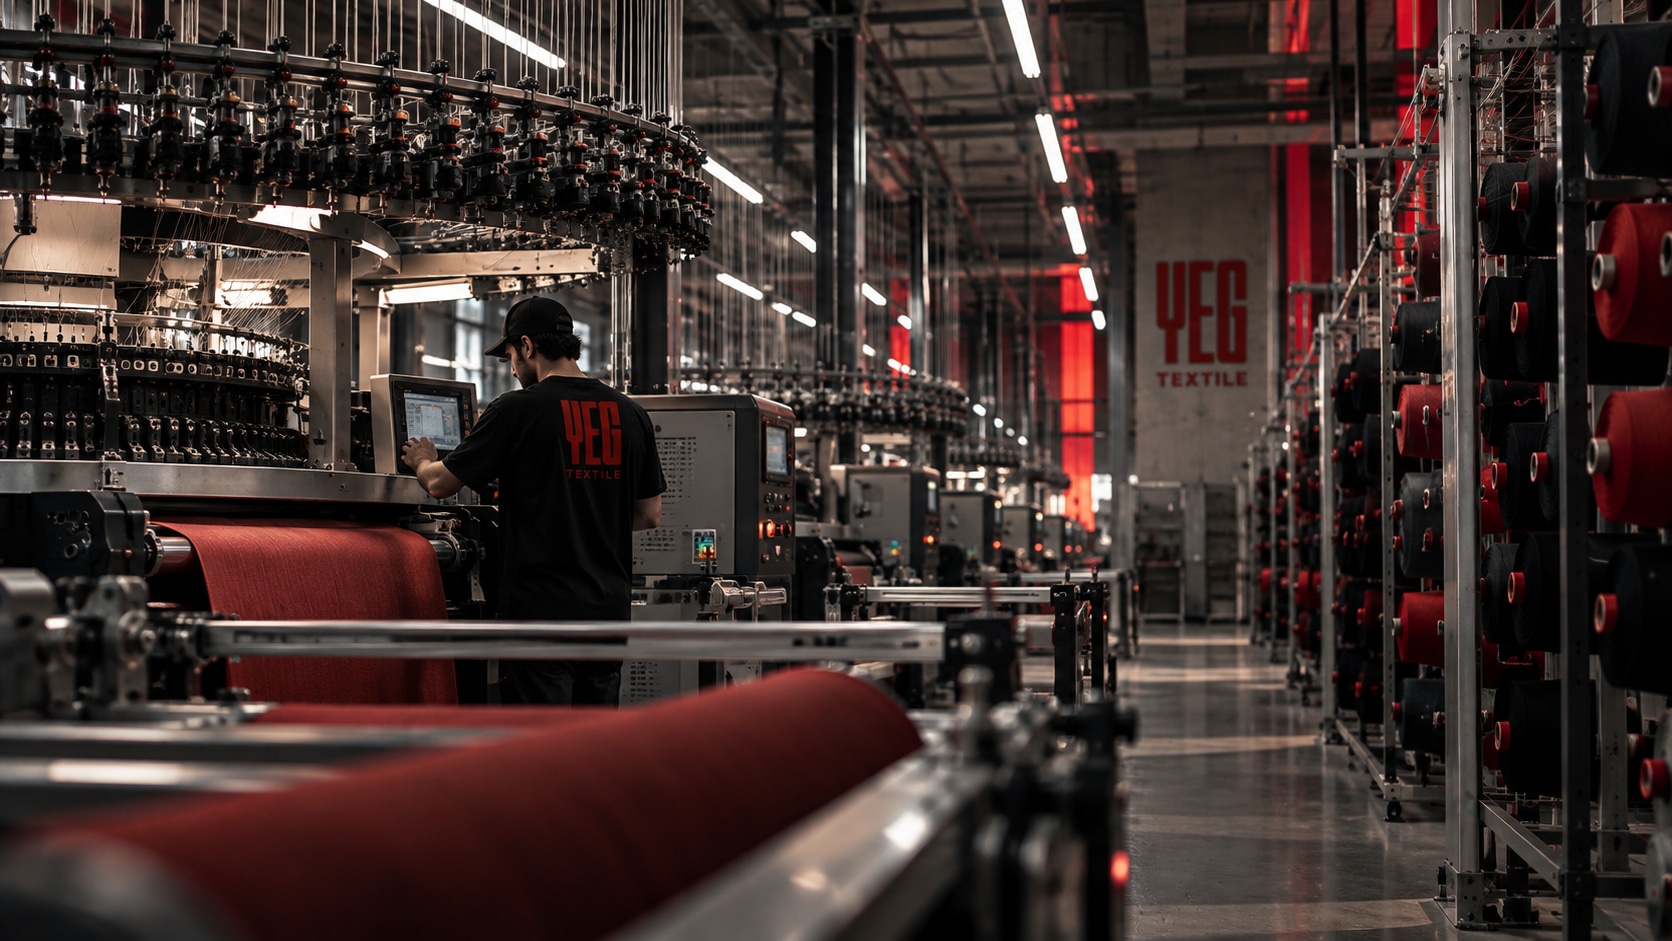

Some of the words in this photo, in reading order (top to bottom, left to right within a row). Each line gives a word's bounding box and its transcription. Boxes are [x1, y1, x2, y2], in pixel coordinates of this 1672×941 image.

[1157, 261, 1247, 364] YEG
[1157, 372, 1247, 387] TEXTILE
[560, 400, 622, 465] YEG
[566, 469, 621, 480] TEXTILE
